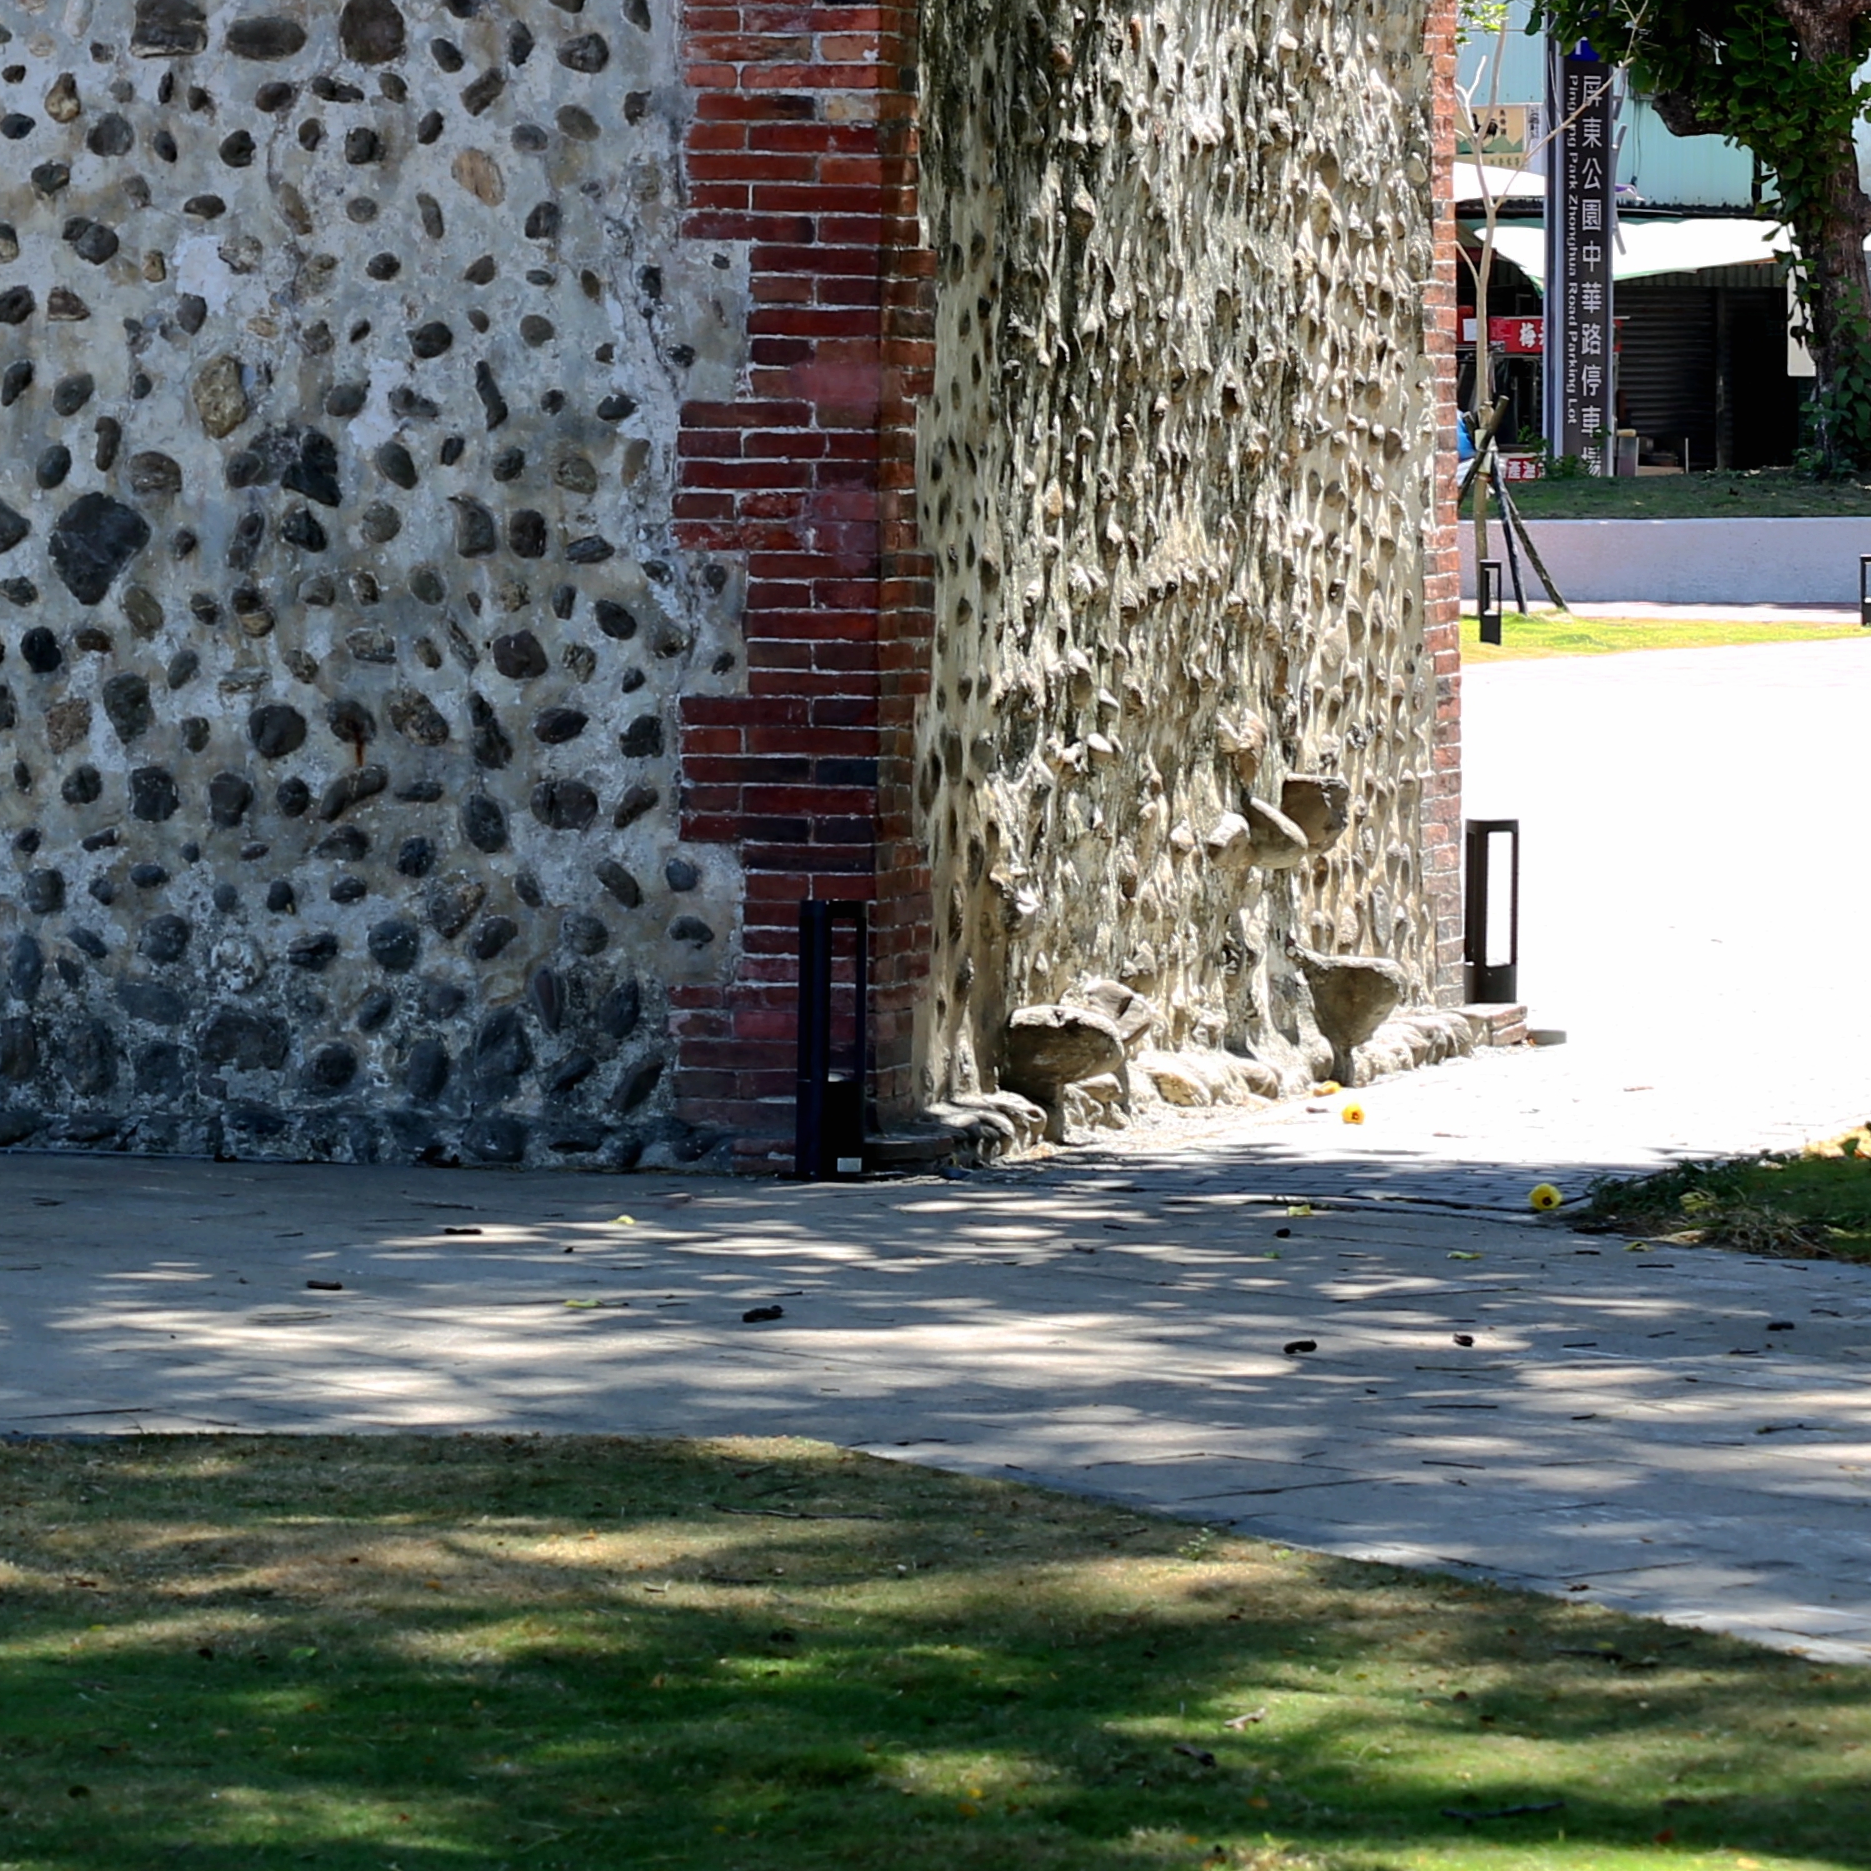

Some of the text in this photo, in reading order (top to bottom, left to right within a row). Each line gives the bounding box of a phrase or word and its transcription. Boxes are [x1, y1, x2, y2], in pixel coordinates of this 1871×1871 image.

[1566, 74, 1579, 424] Pingng Park Zhonghua Road Parking Lot
